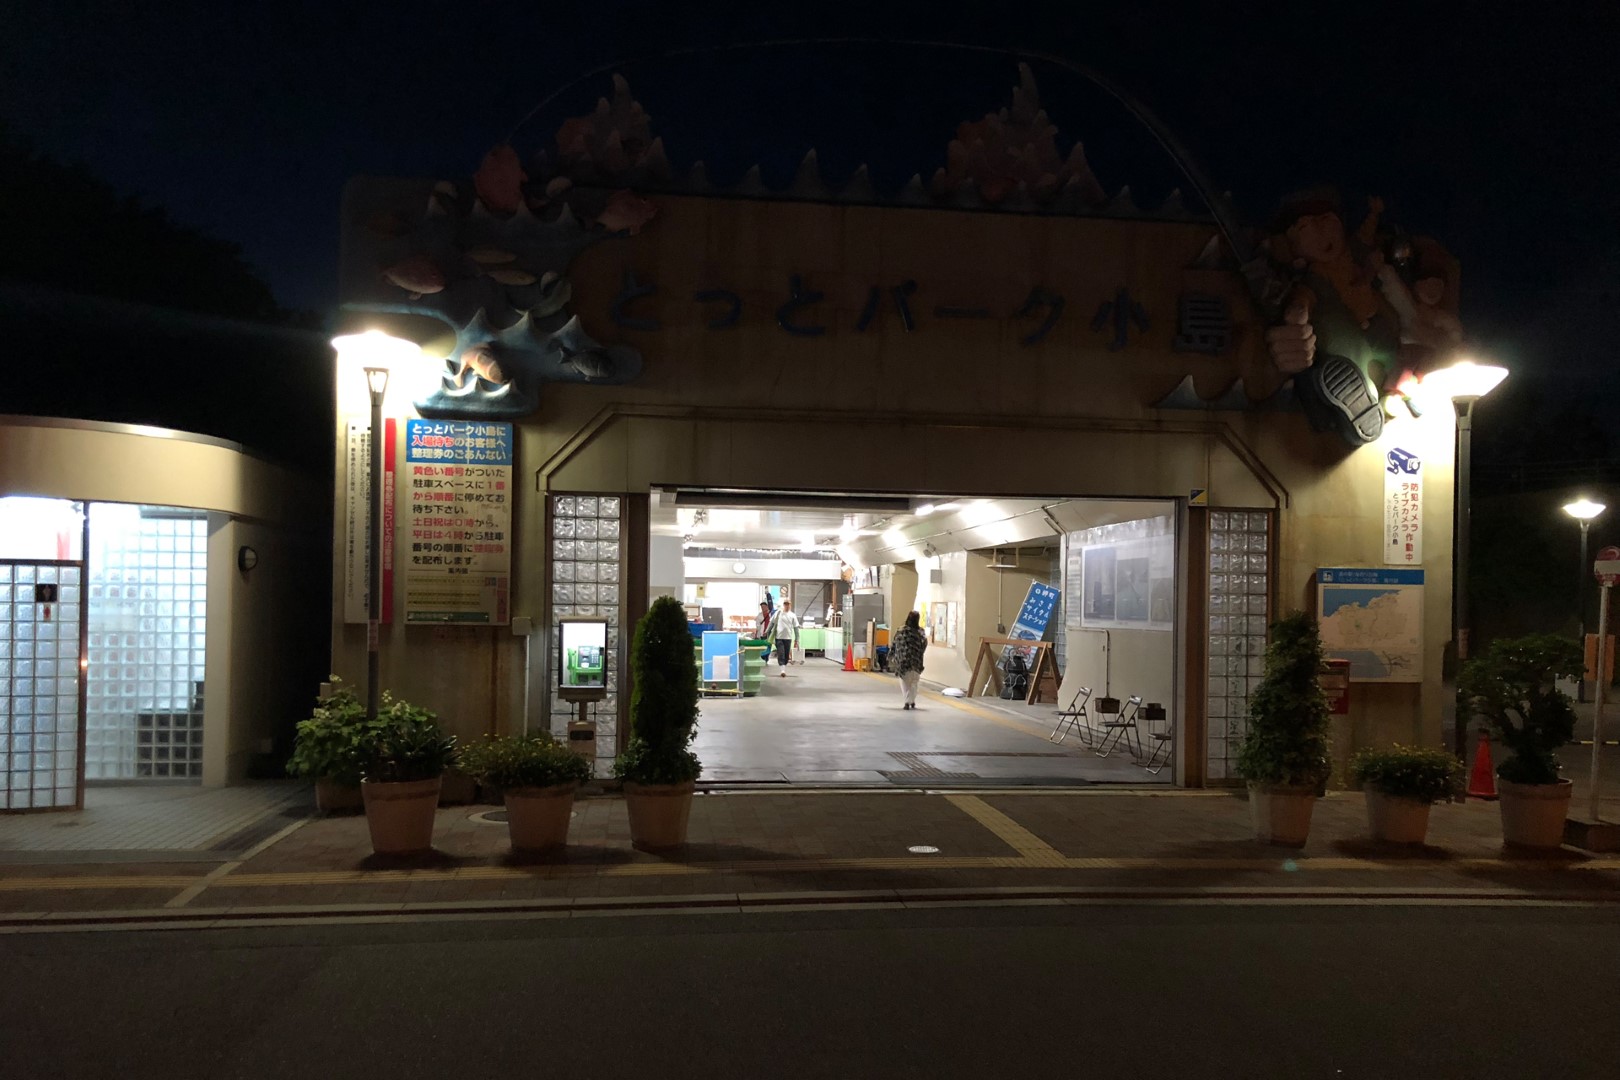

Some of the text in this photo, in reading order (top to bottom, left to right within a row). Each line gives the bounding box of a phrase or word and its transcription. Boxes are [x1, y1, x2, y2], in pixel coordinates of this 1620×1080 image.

[412, 424, 506, 437] とっとパーク小島に
[411, 435, 506, 449] 入場待ちのお客様へ
[411, 447, 506, 461] 整理券のごあんない
[413, 466, 505, 478] 黄色い番号がついた
[412, 491, 505, 504] から順番に停めてお
[412, 504, 470, 515] 待ち下さい。
[1410, 483, 1419, 533] 防犯カメラ
[1405, 533, 1414, 562] 作動中
